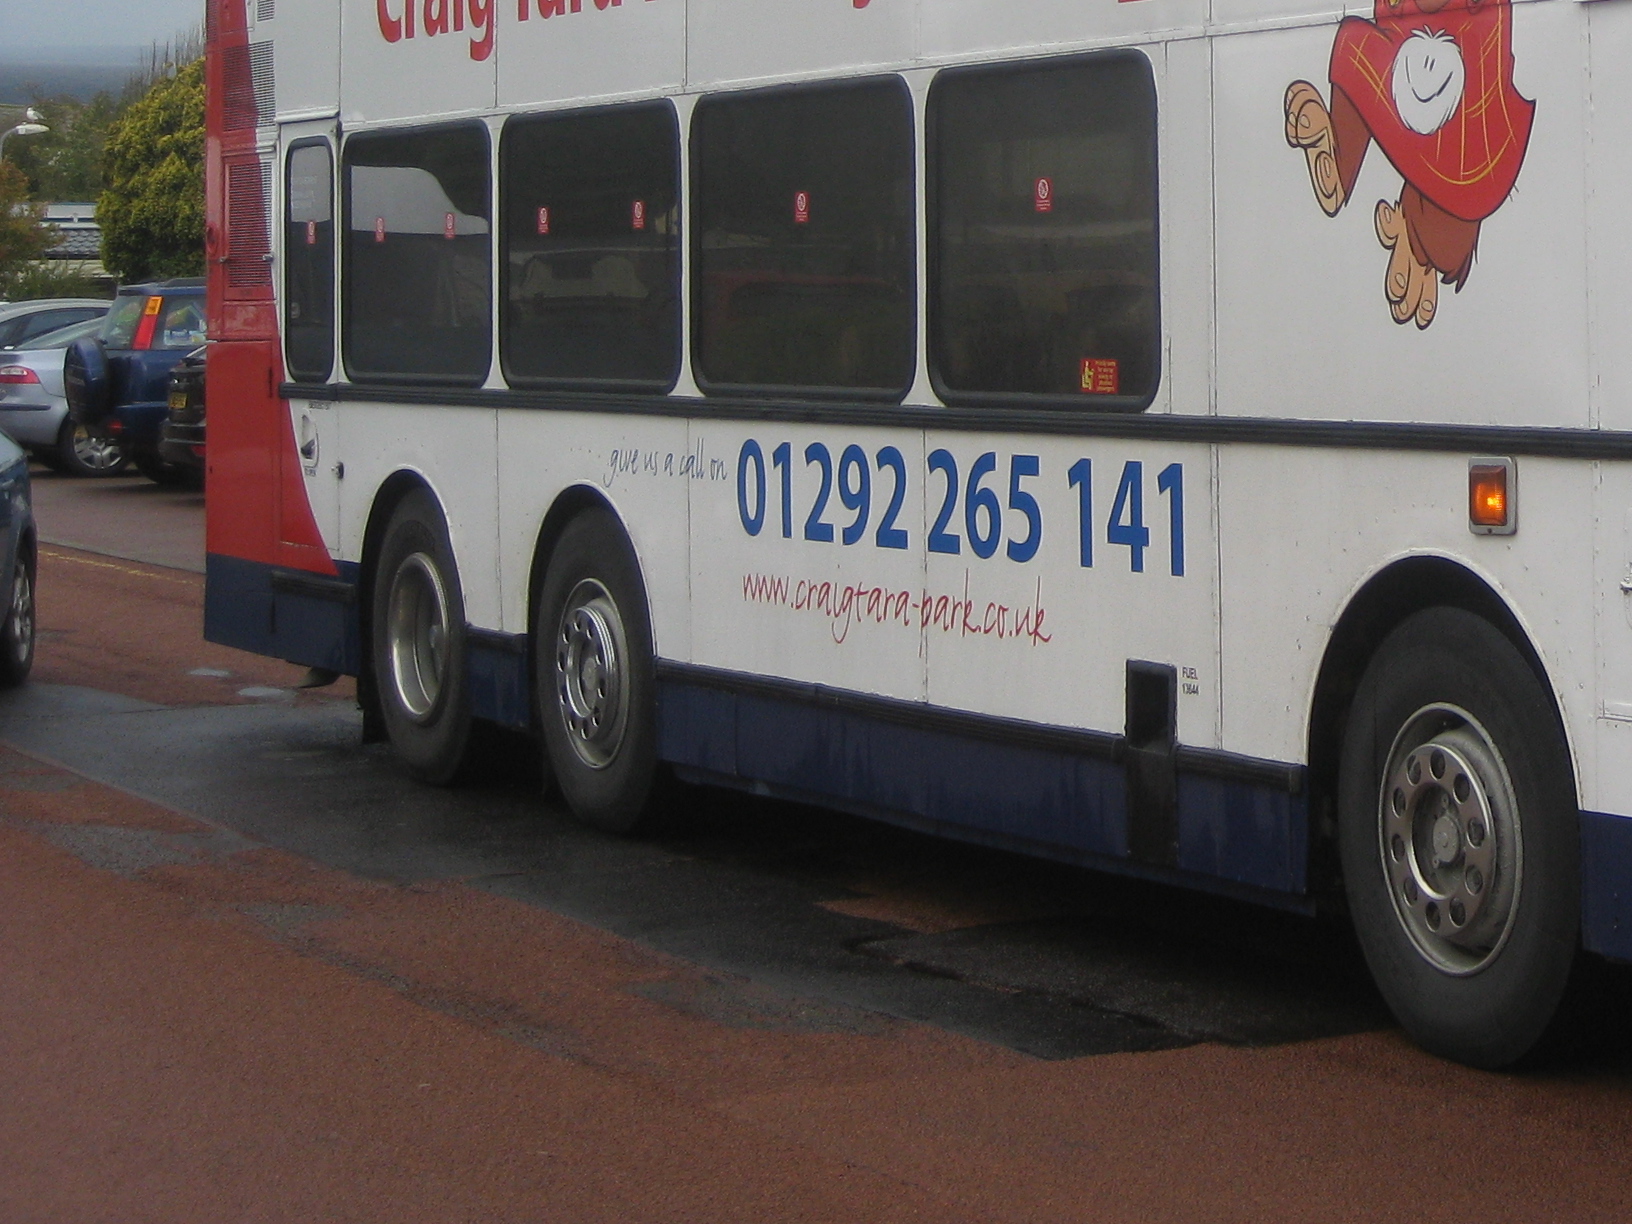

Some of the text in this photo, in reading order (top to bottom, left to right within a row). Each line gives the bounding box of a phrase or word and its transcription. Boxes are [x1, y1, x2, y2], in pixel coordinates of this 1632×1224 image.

[602, 437, 728, 488] give us a call on
[737, 438, 1186, 578] 01292 265 141
[742, 568, 1053, 657] www.craigtara-park.co.uk
